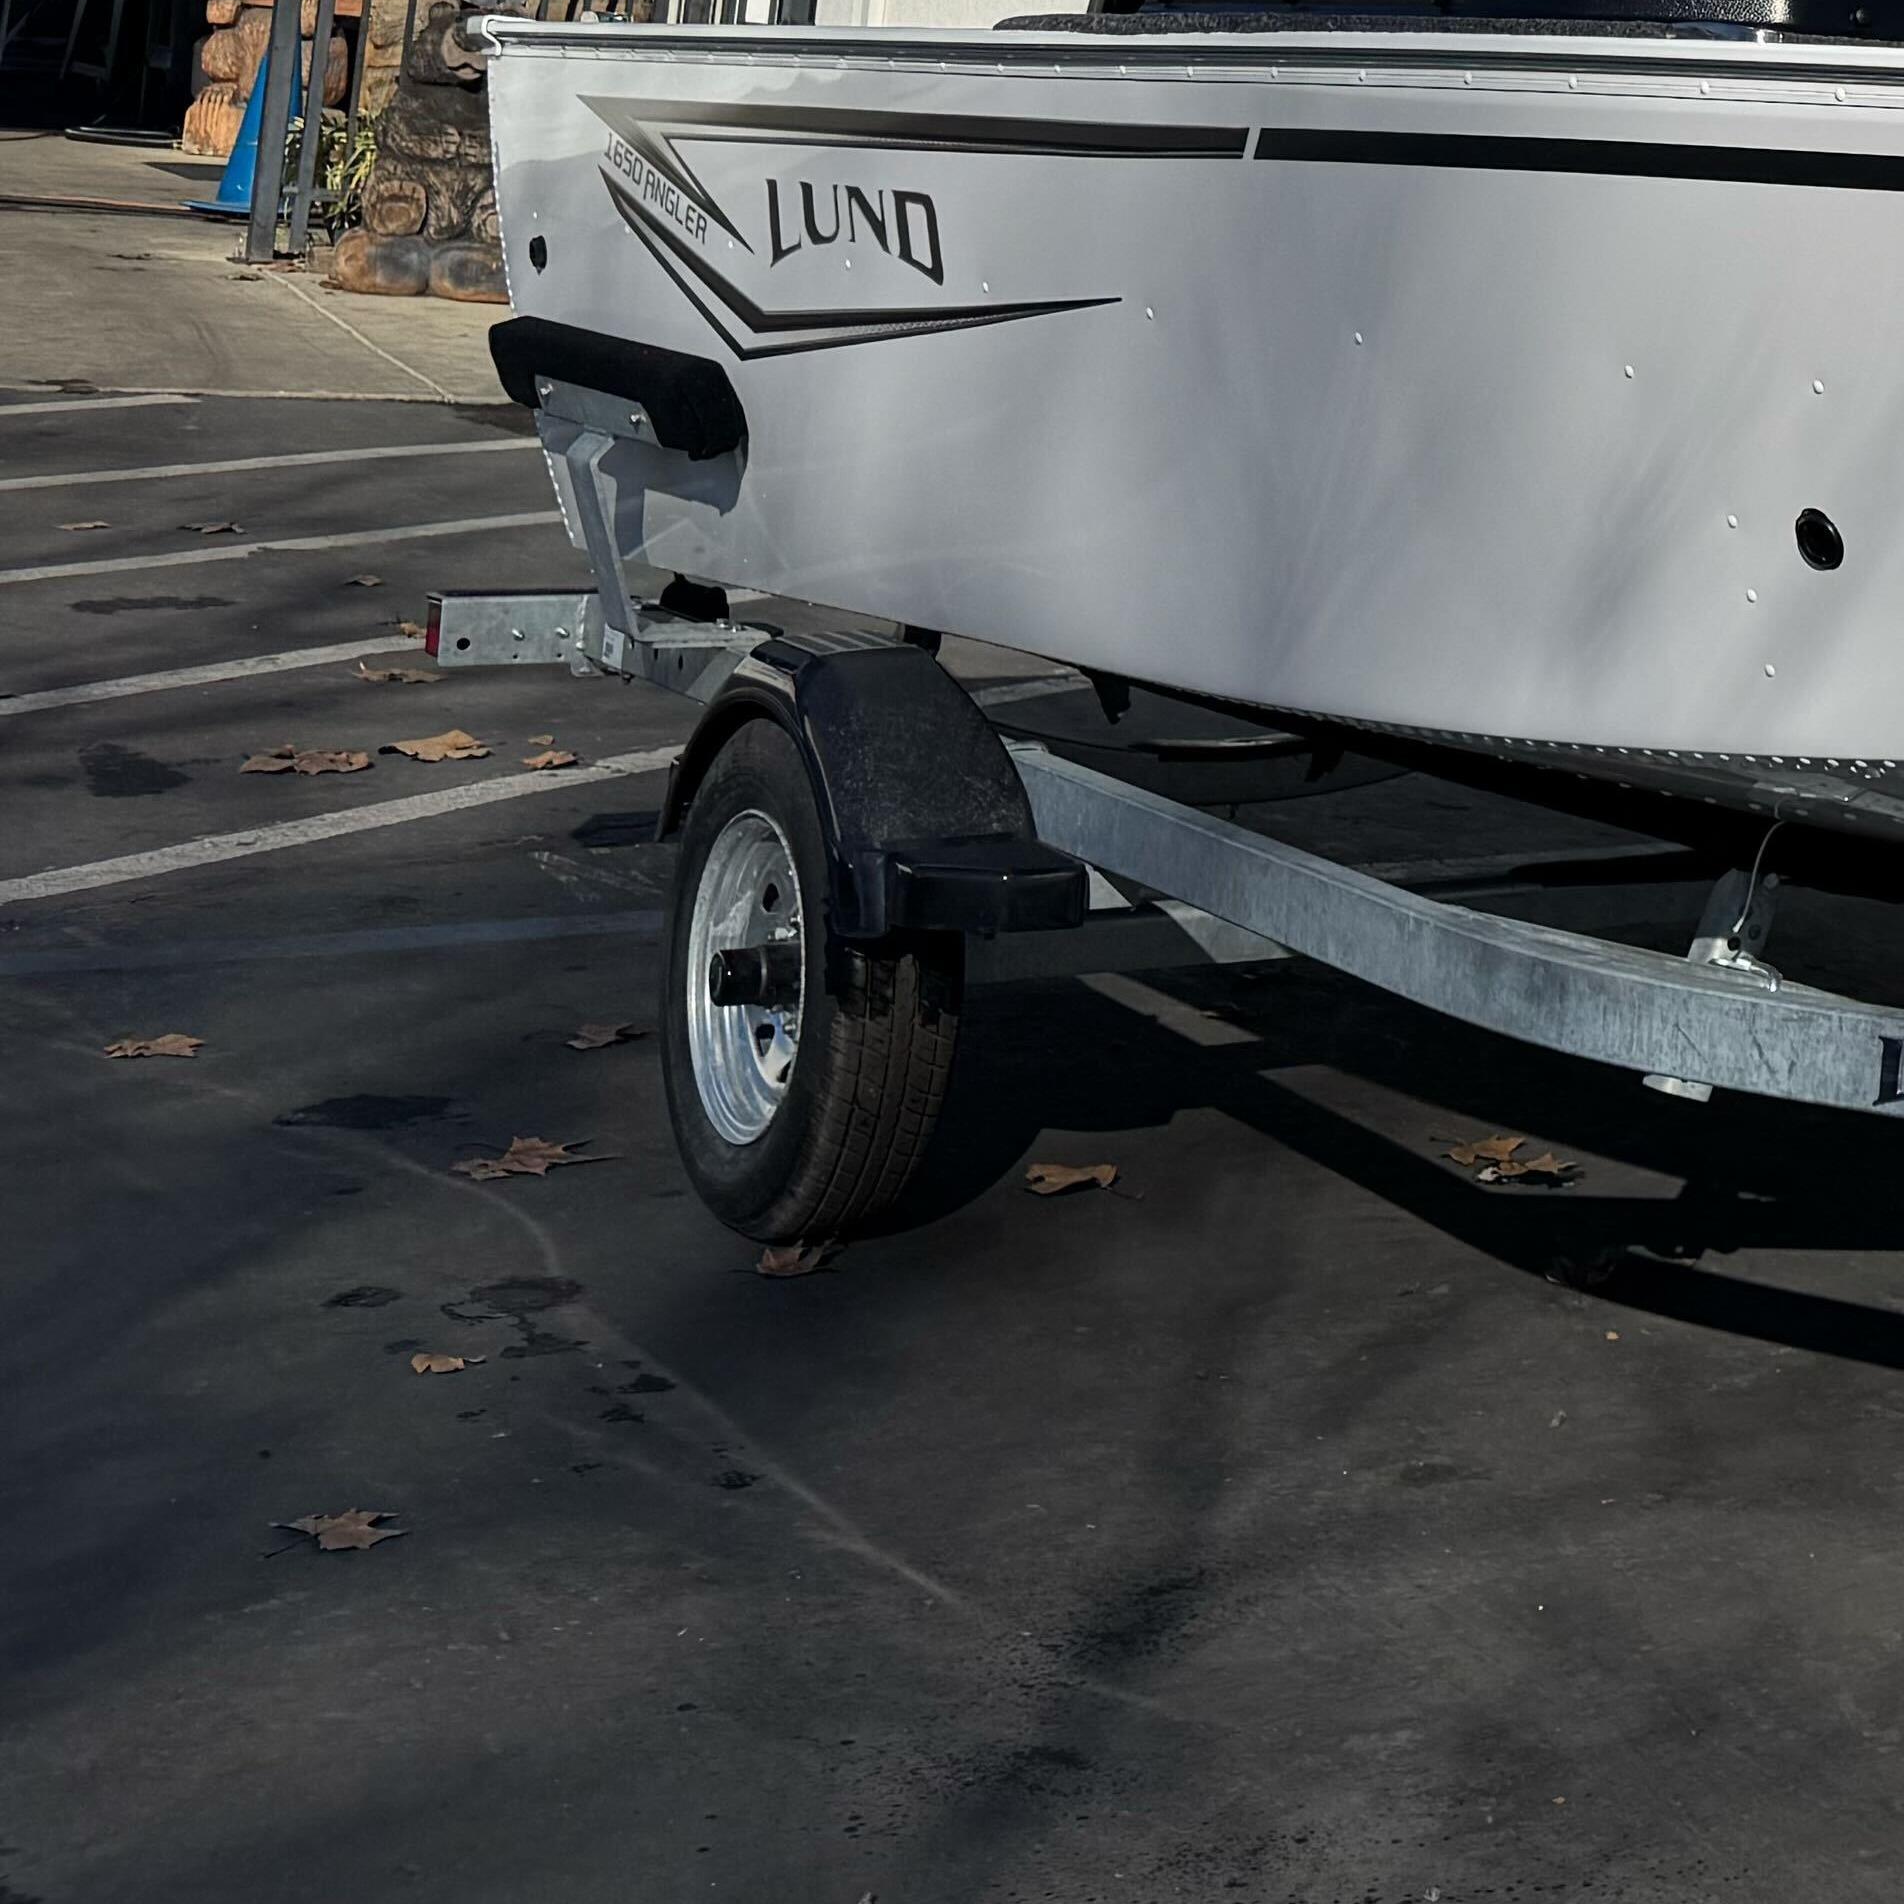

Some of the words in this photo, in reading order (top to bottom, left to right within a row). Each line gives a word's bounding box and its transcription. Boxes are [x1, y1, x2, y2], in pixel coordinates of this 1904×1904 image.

[603, 132, 644, 186] 1650
[642, 168, 707, 246] ANGLER
[765, 178, 944, 287] LUND
